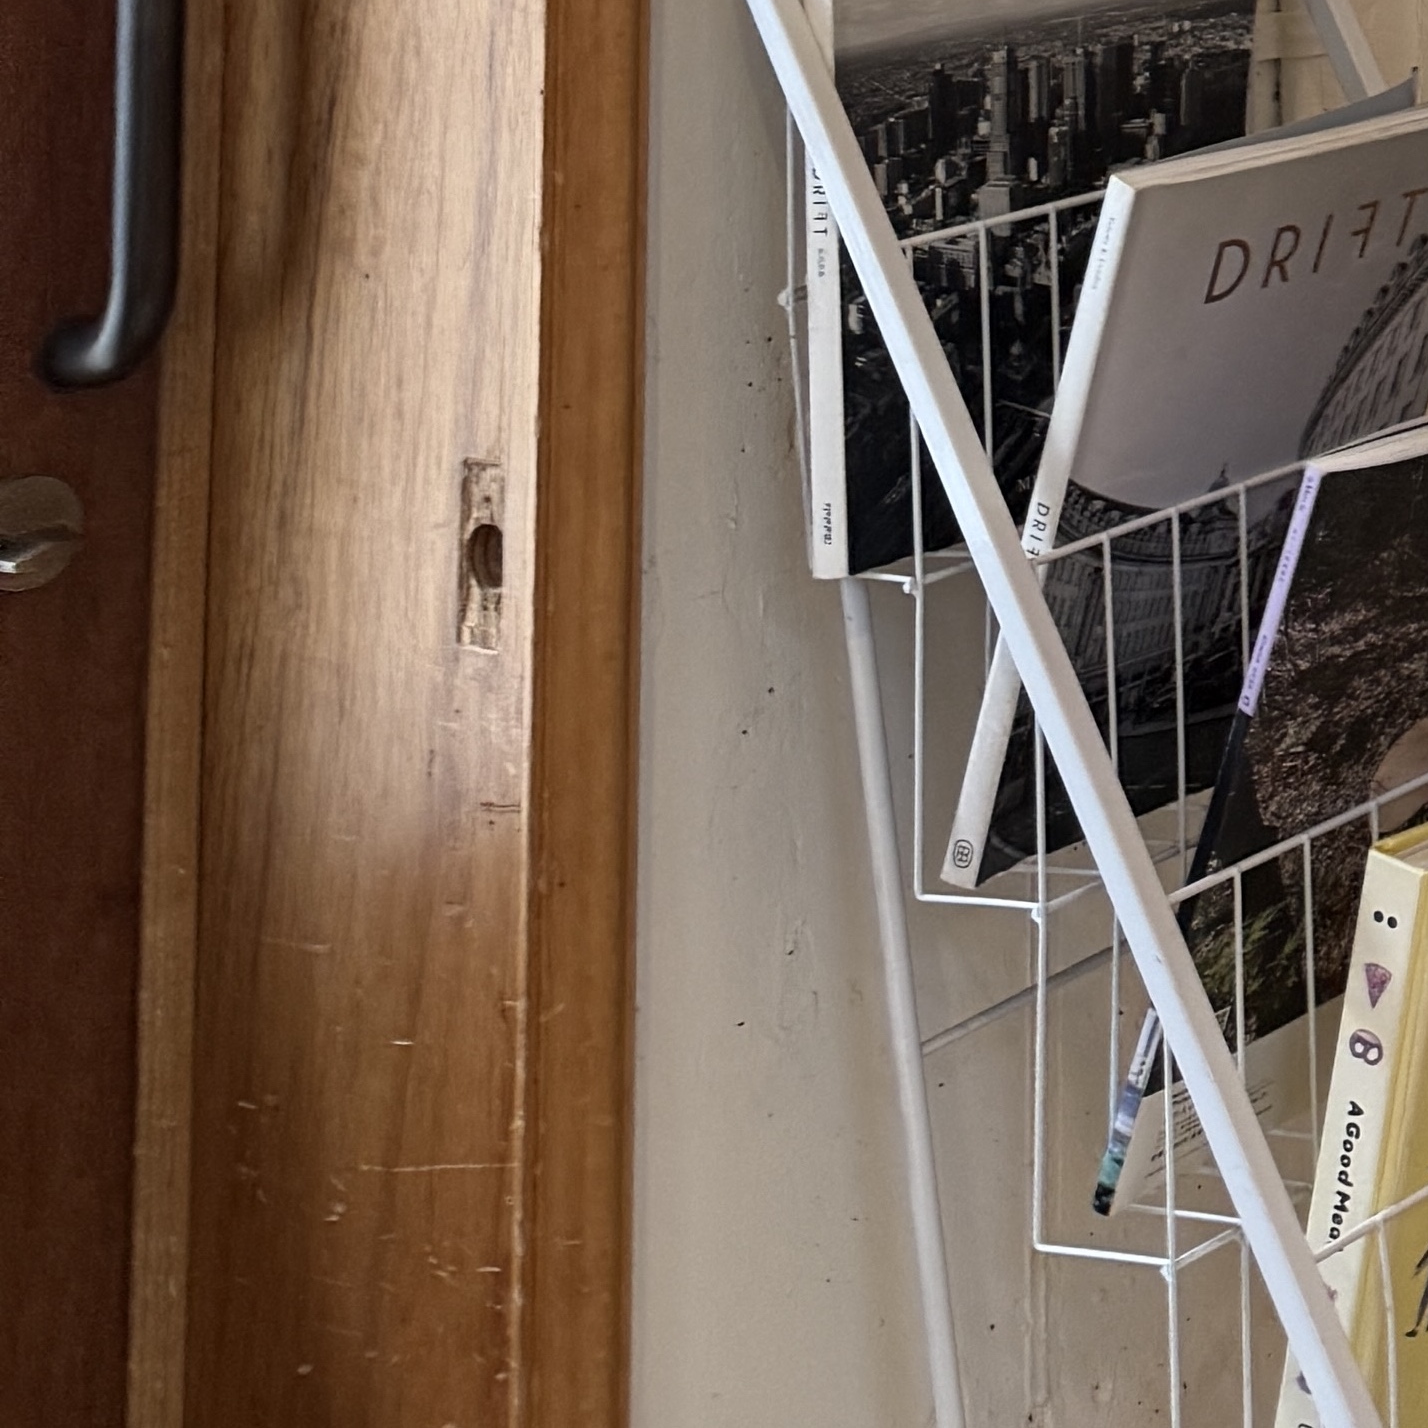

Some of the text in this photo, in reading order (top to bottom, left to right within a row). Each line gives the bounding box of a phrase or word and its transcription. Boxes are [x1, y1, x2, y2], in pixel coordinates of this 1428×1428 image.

[1026, 502, 1050, 558] DRIF
[1327, 1100, 1364, 1243] A Good Mea
